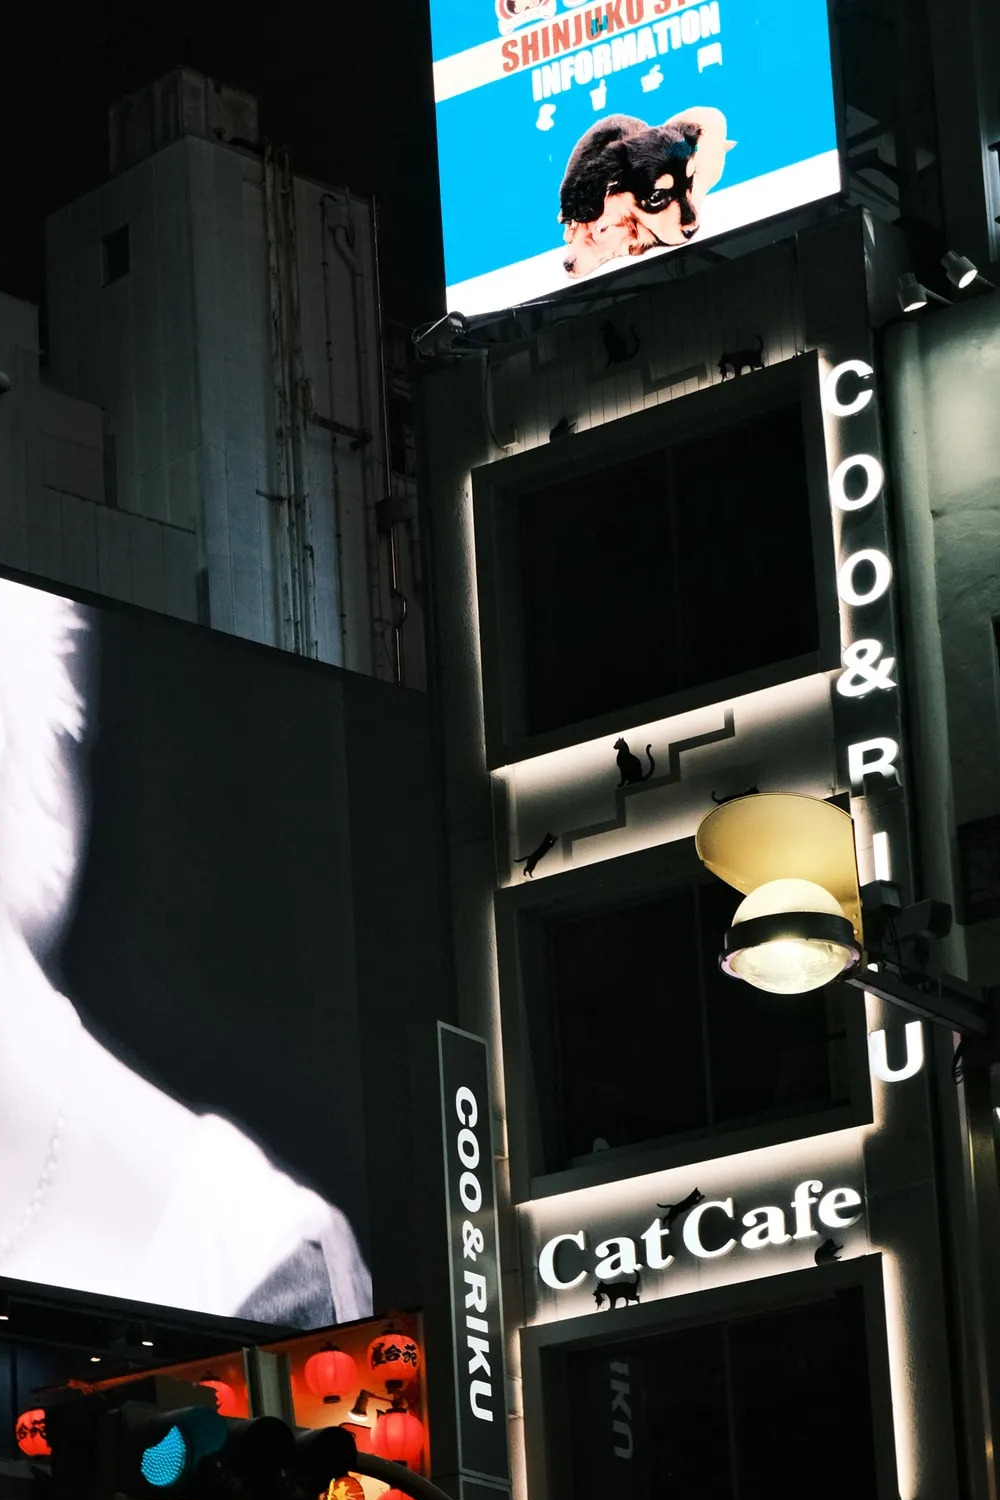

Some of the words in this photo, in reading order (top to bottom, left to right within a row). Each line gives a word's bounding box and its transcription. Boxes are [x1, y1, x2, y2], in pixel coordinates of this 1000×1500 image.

[501, 0, 645, 73] SHINJUKU
[531, 1, 721, 102] INFORMATION
[848, 737, 925, 1082] RIU
[455, 1086, 483, 1214] COO
[462, 1221, 485, 1262] &
[538, 1217, 677, 1291] Cat
[683, 1180, 863, 1259] Cafe
[464, 1271, 495, 1423] RIKU
